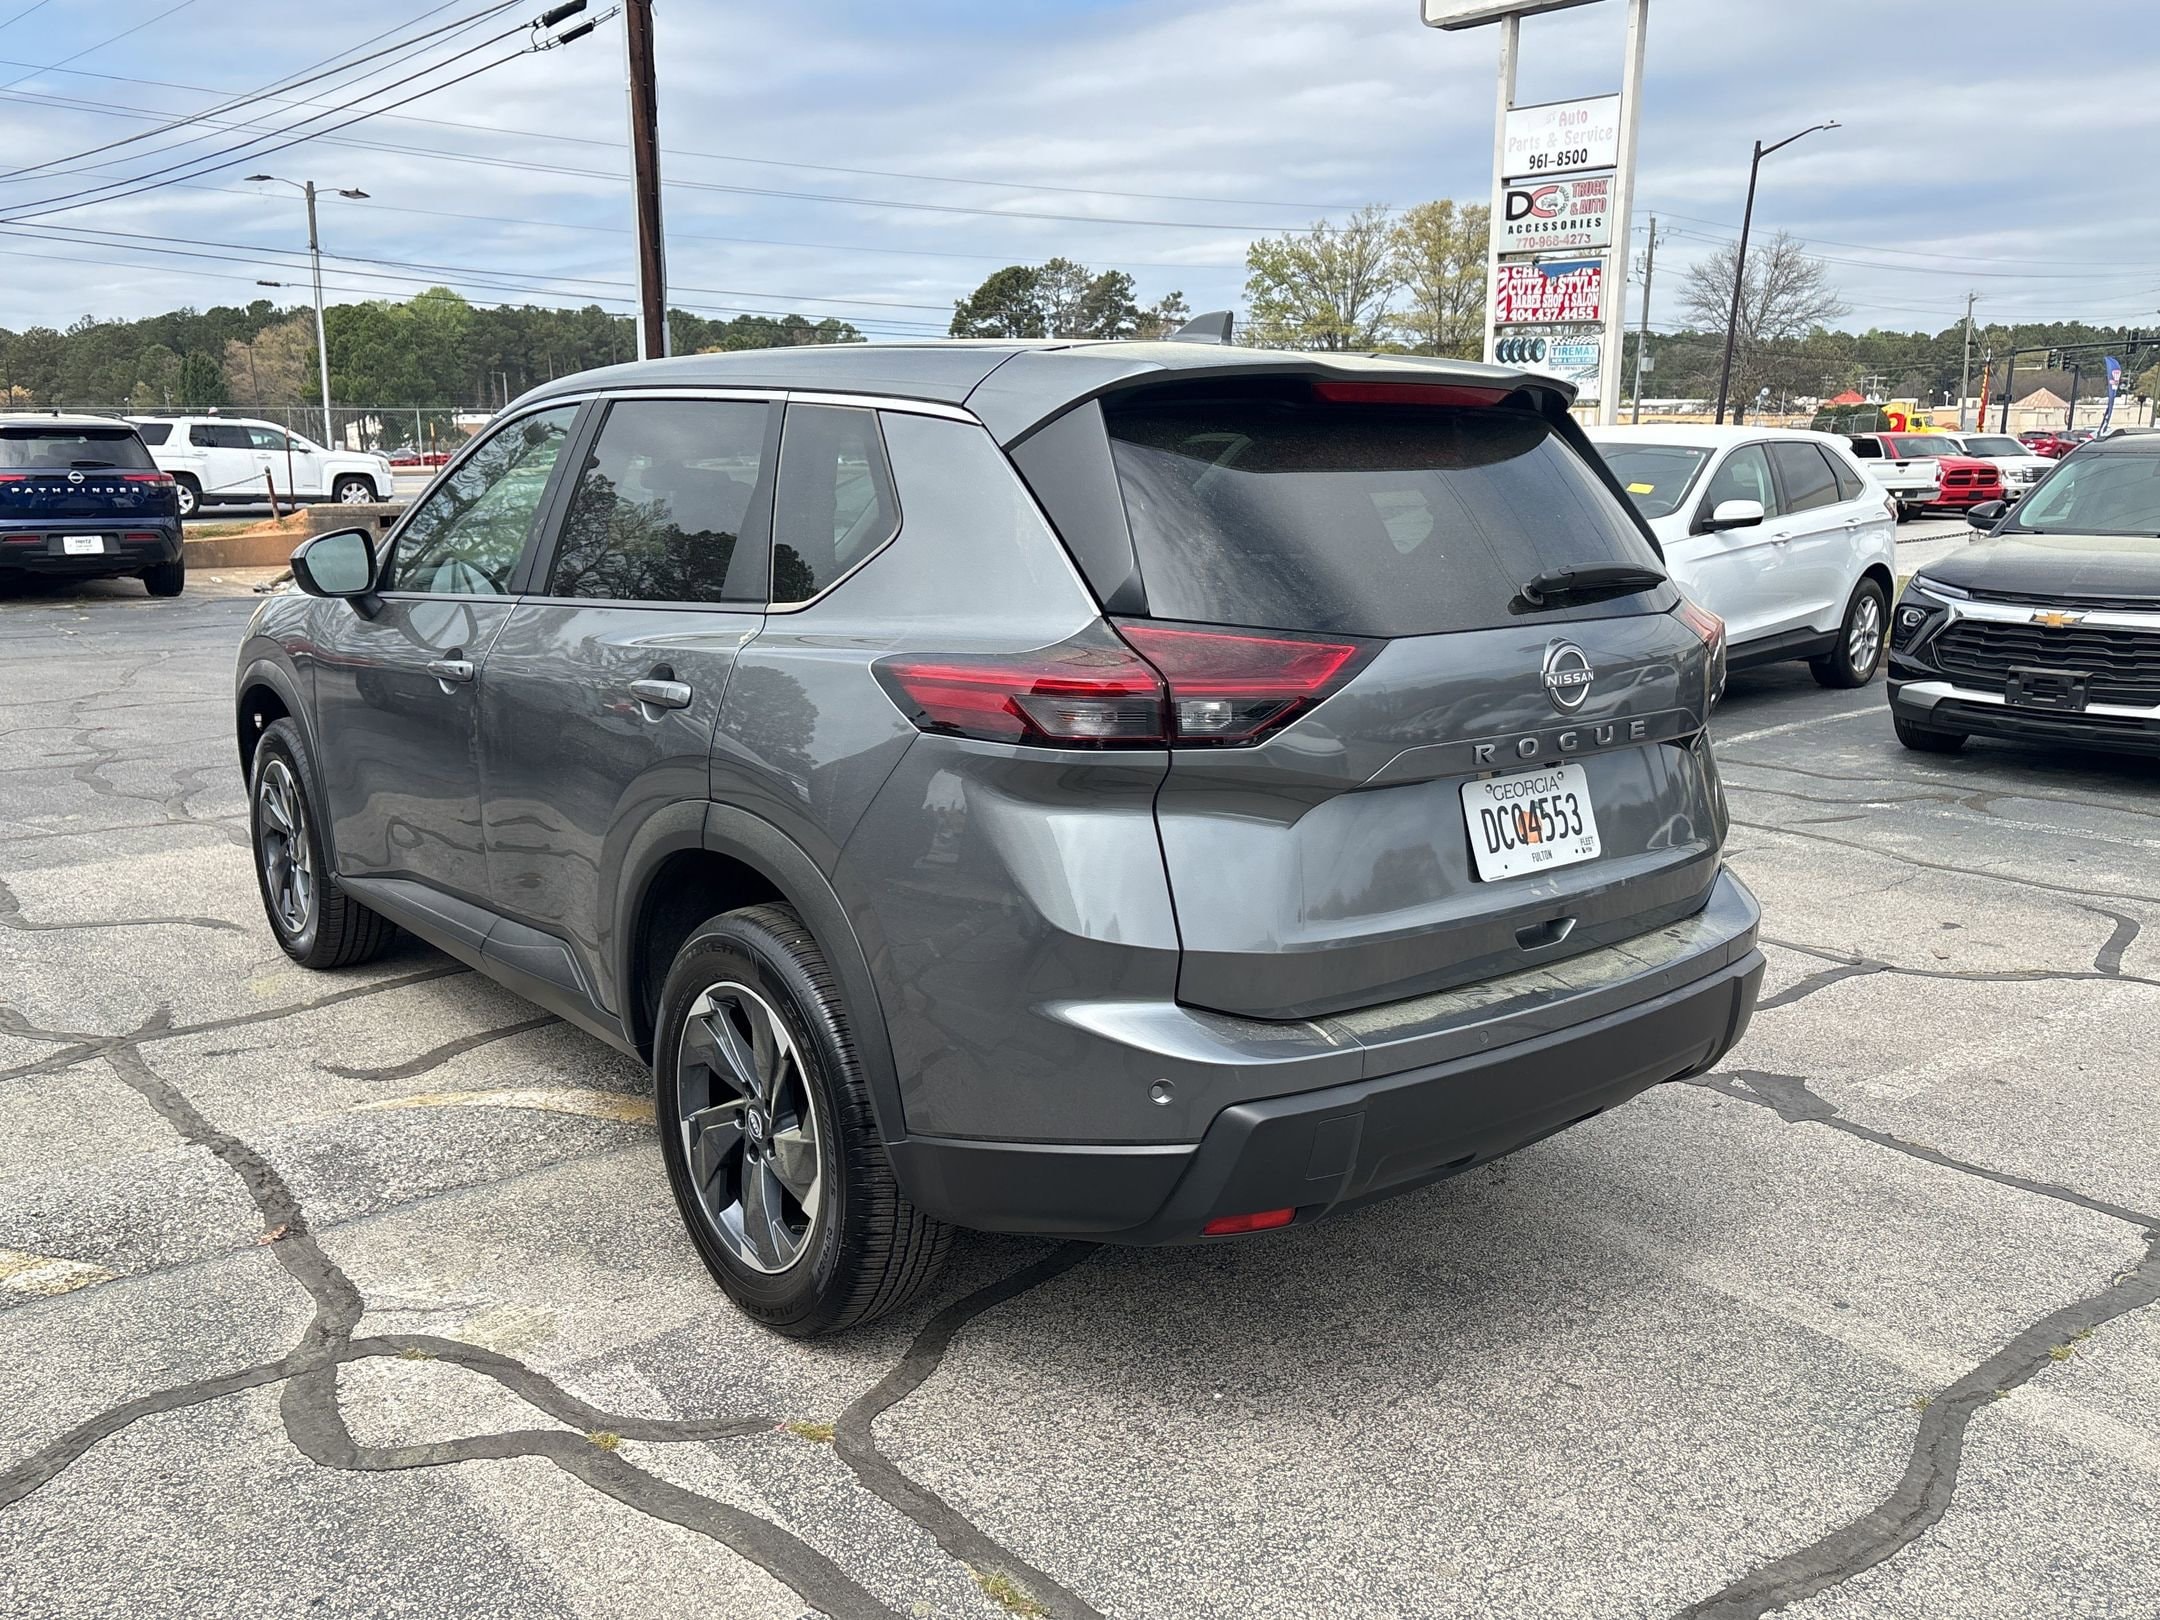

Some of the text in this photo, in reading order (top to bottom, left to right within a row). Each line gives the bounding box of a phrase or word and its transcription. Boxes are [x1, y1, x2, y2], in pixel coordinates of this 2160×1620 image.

[1559, 109, 1588, 127] Auto
[1509, 126, 1613, 152] Parts & Service
[1529, 148, 1588, 170] 961-8500
[1572, 180, 1608, 198] TRUCK
[1506, 185, 1559, 221] DC
[1508, 218, 1601, 235] ACCESSORIES
[1508, 278, 1544, 295] CUTZ
[1557, 275, 1600, 294] STYLE
[1512, 294, 1541, 309] BARBER
[1543, 294, 1563, 308] SHOP
[1571, 292, 1599, 308] SALON
[1508, 307, 1595, 321] 404.437.4455
[1552, 346, 1597, 356] TIREMAX
[1546, 670, 1594, 686] NISSAN
[1473, 720, 1647, 765] ROGUE
[1493, 776, 1560, 801] GEORGIA
[1481, 793, 1583, 854] DCQ4553
[1531, 849, 1553, 862] FULTON
